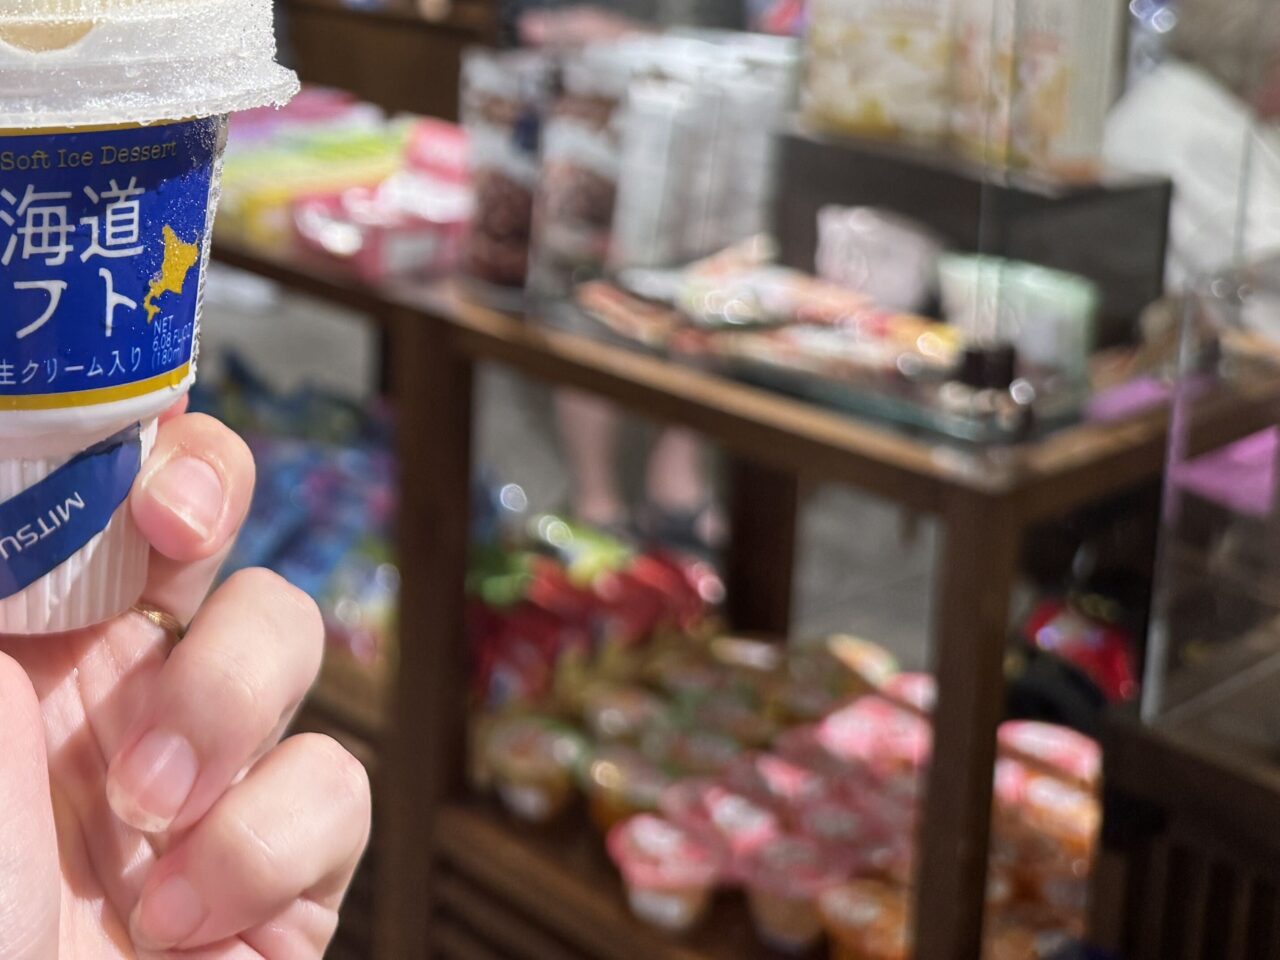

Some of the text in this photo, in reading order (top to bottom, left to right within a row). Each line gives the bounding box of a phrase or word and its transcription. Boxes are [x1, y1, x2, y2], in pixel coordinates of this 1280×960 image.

[0, 149, 49, 171] Soft
[58, 149, 93, 168] Ice
[100, 141, 178, 165] Dessert
[153, 314, 175, 337] NET
[152, 331, 172, 352] 6.08
